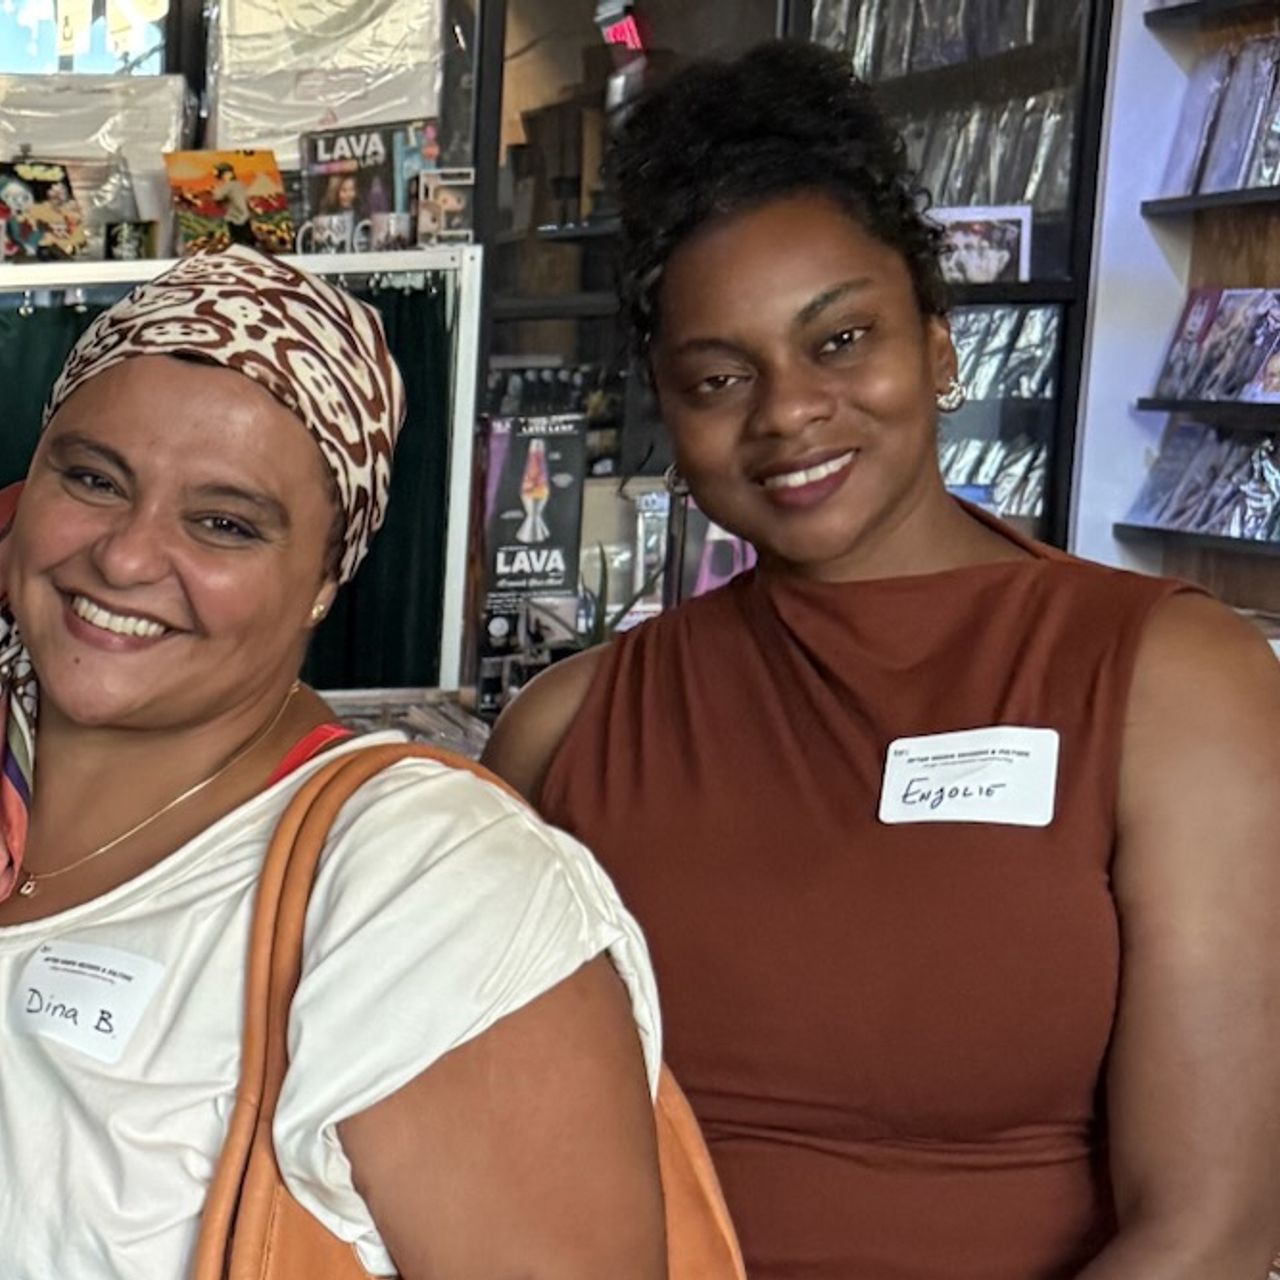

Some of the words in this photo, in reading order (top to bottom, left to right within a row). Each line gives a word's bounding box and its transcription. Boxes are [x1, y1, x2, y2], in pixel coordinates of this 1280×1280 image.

[316, 131, 386, 163] LAVA
[496, 549, 566, 574] LAVA
[26, 987, 79, 1027] Dina
